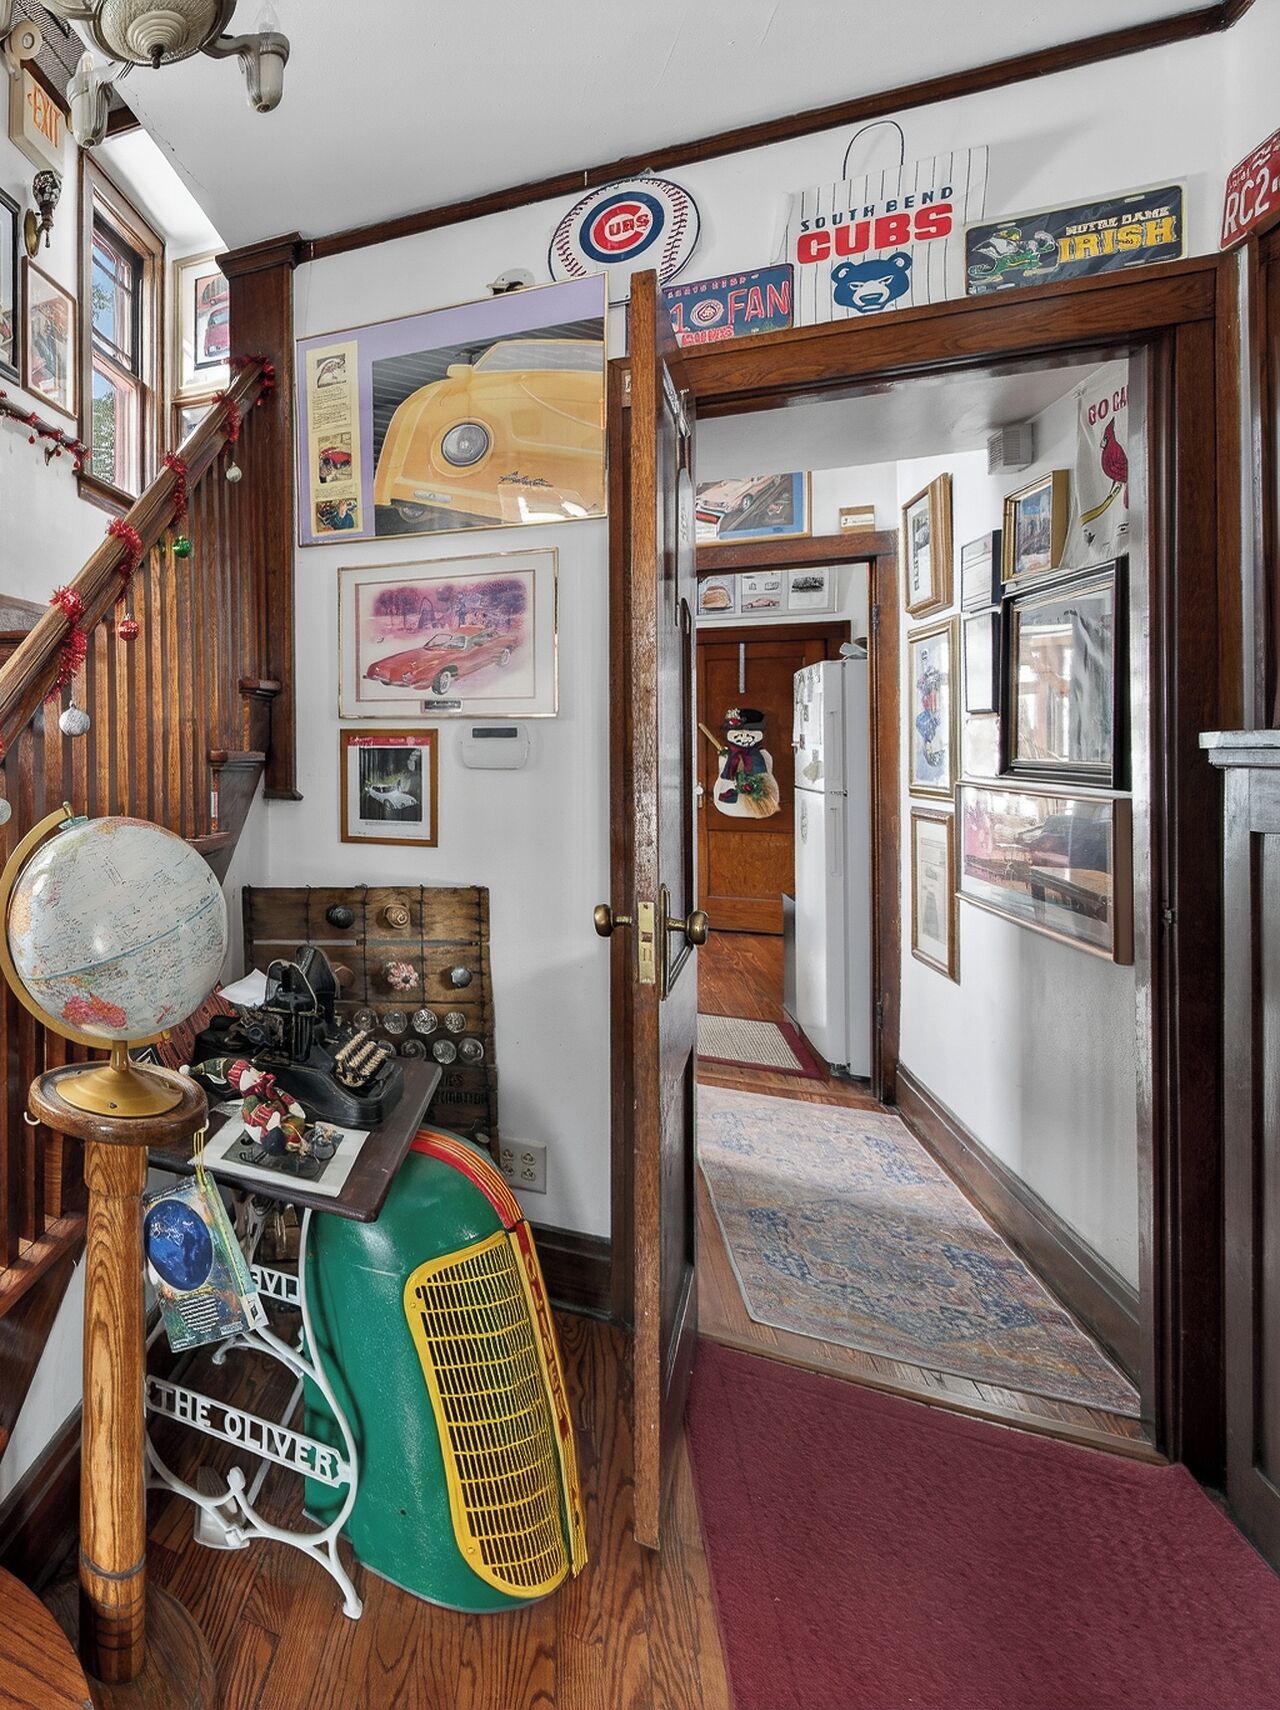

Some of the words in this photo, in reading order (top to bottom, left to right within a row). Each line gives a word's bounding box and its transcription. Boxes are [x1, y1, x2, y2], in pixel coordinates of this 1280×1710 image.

[27, 83, 61, 148] EXIT
[800, 203, 876, 232] SOUTH
[885, 186, 953, 213] BEND
[1066, 217, 1118, 236] NOTRE
[1121, 206, 1170, 225] DAME
[797, 203, 953, 264] CUBS
[1058, 215, 1177, 264] IRISH
[727, 280, 790, 325] FAN
[1088, 398, 1109, 426] GO
[155, 1383, 212, 1428] THE
[223, 1411, 338, 1482] OLIVER
